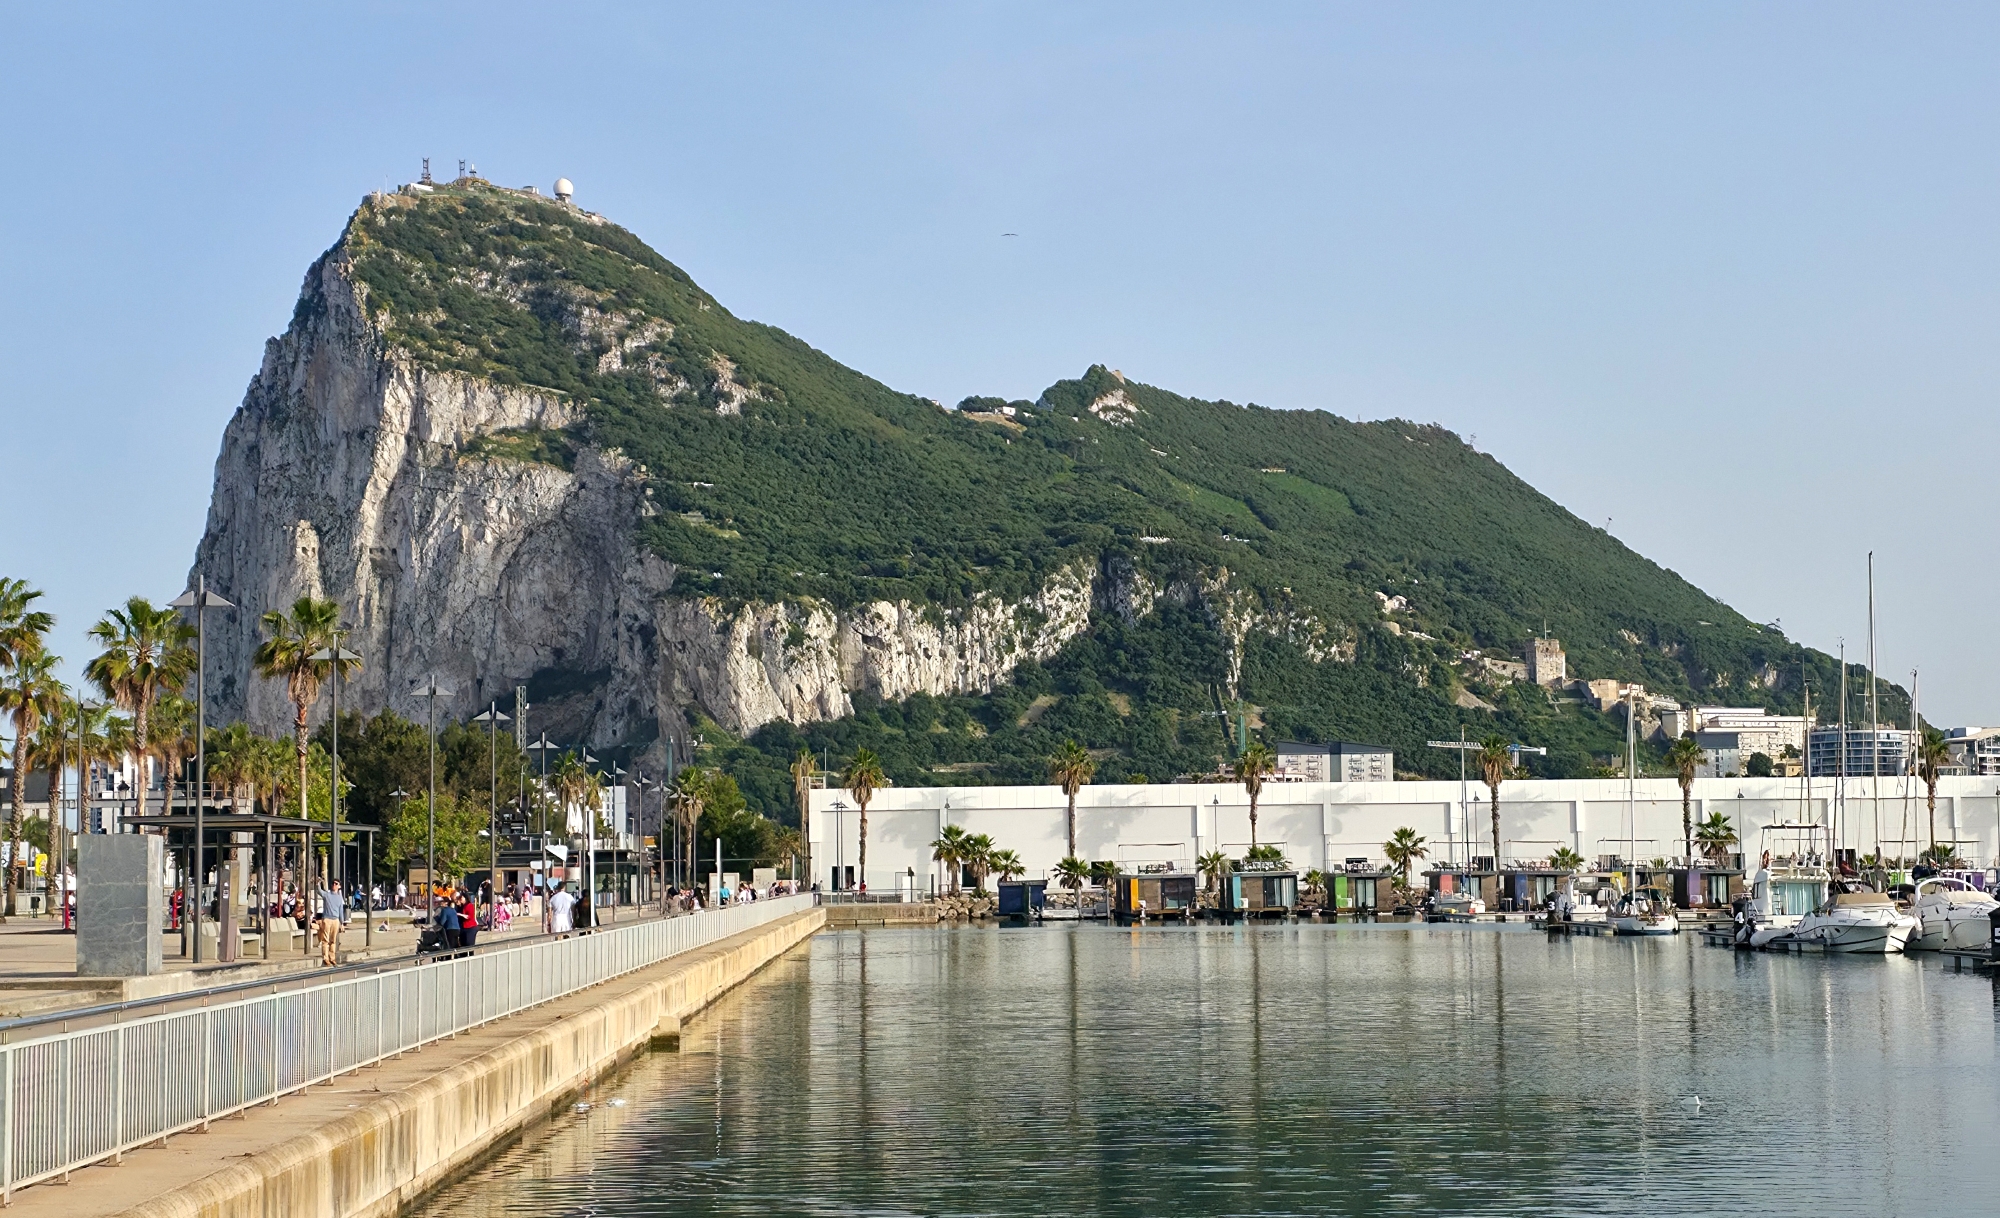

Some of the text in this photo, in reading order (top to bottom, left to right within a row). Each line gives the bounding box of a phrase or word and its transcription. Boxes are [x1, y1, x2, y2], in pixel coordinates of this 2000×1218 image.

[1428, 896, 1436, 904] 2
[1548, 901, 1556, 910] 3
[1735, 912, 1744, 924] 4
